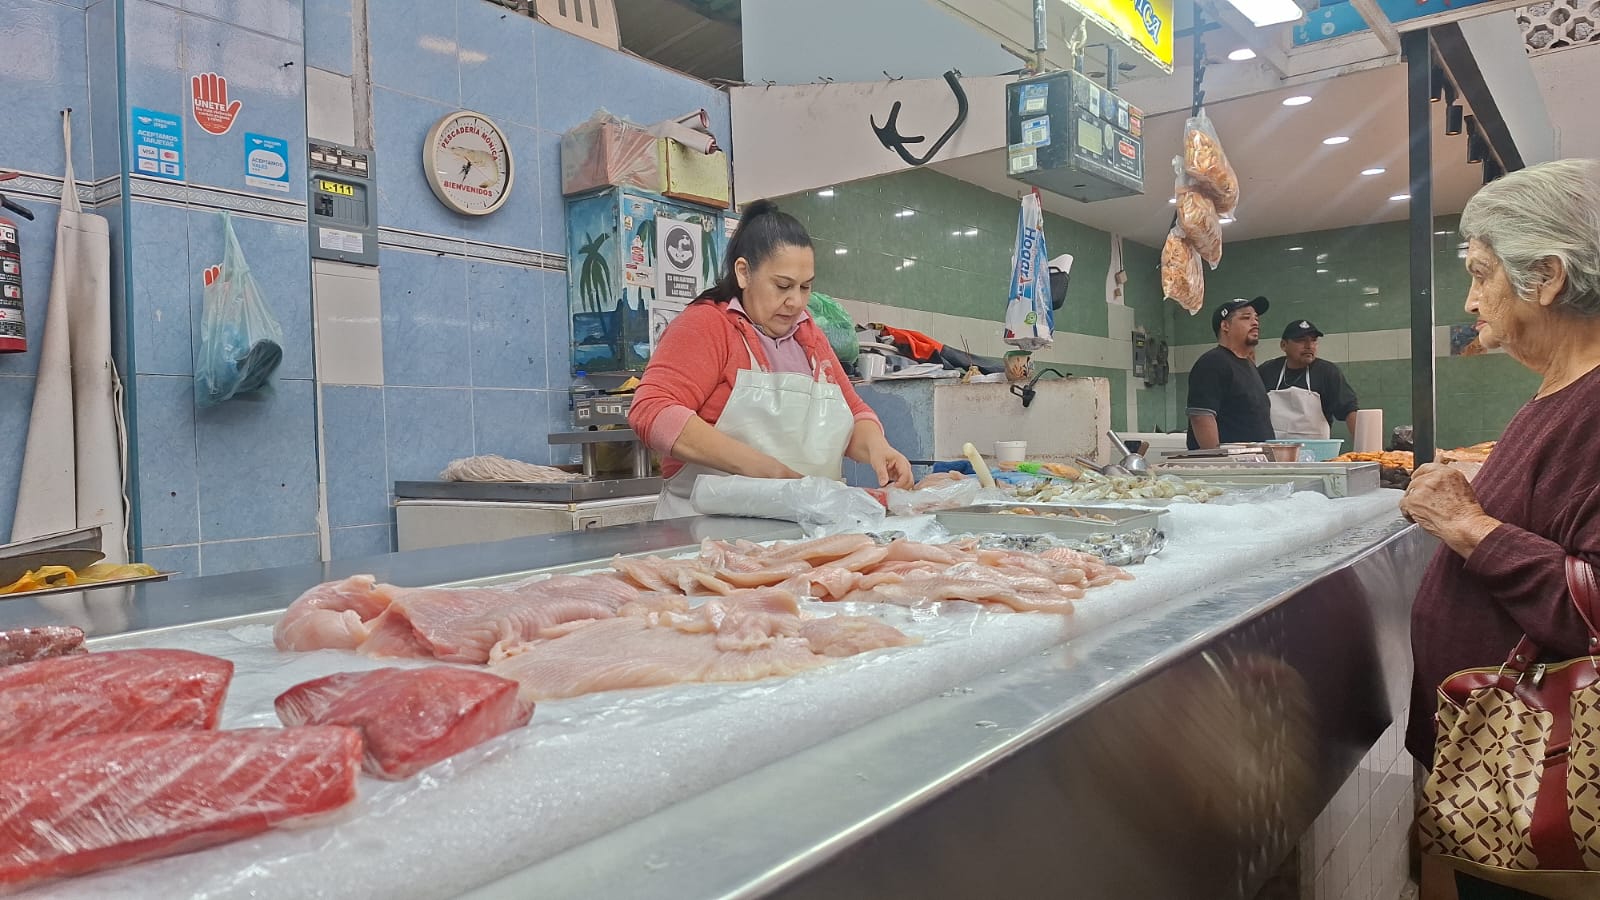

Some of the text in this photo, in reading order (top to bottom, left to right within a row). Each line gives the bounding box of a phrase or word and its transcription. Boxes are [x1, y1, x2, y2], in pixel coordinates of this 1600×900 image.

[194, 97, 226, 111] ÚNETE
[137, 129, 178, 142] ACEPTAMOS
[143, 136, 175, 147] TARJETAS
[251, 157, 284, 168] ACEPTAMOS
[322, 181, 353, 195] L-111
[443, 180, 493, 197] BIENVENIDOS
[1021, 226, 1036, 278] Hogar
